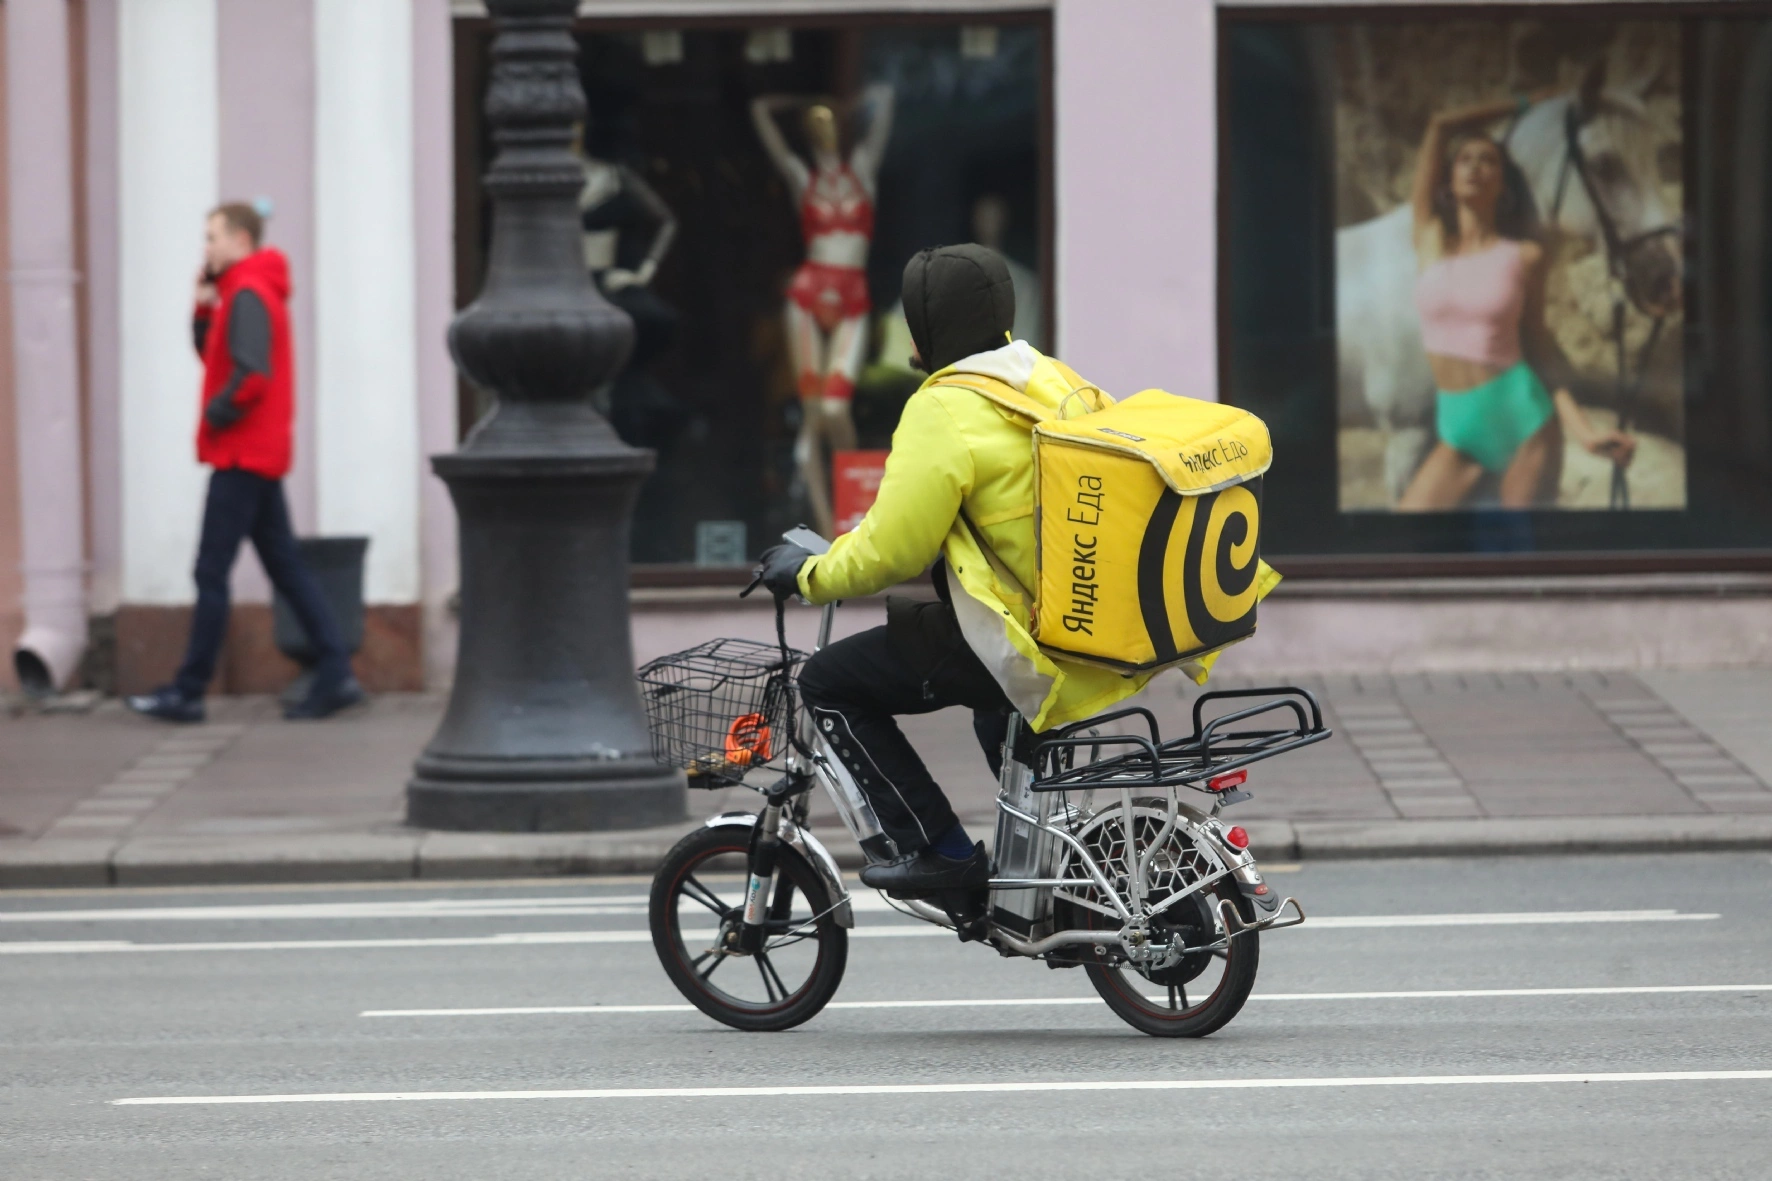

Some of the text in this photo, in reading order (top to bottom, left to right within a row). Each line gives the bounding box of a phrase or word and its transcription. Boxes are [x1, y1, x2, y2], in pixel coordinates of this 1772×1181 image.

[1217, 438, 1248, 463] Еда
[1062, 475, 1105, 637] Яндекс Еда
